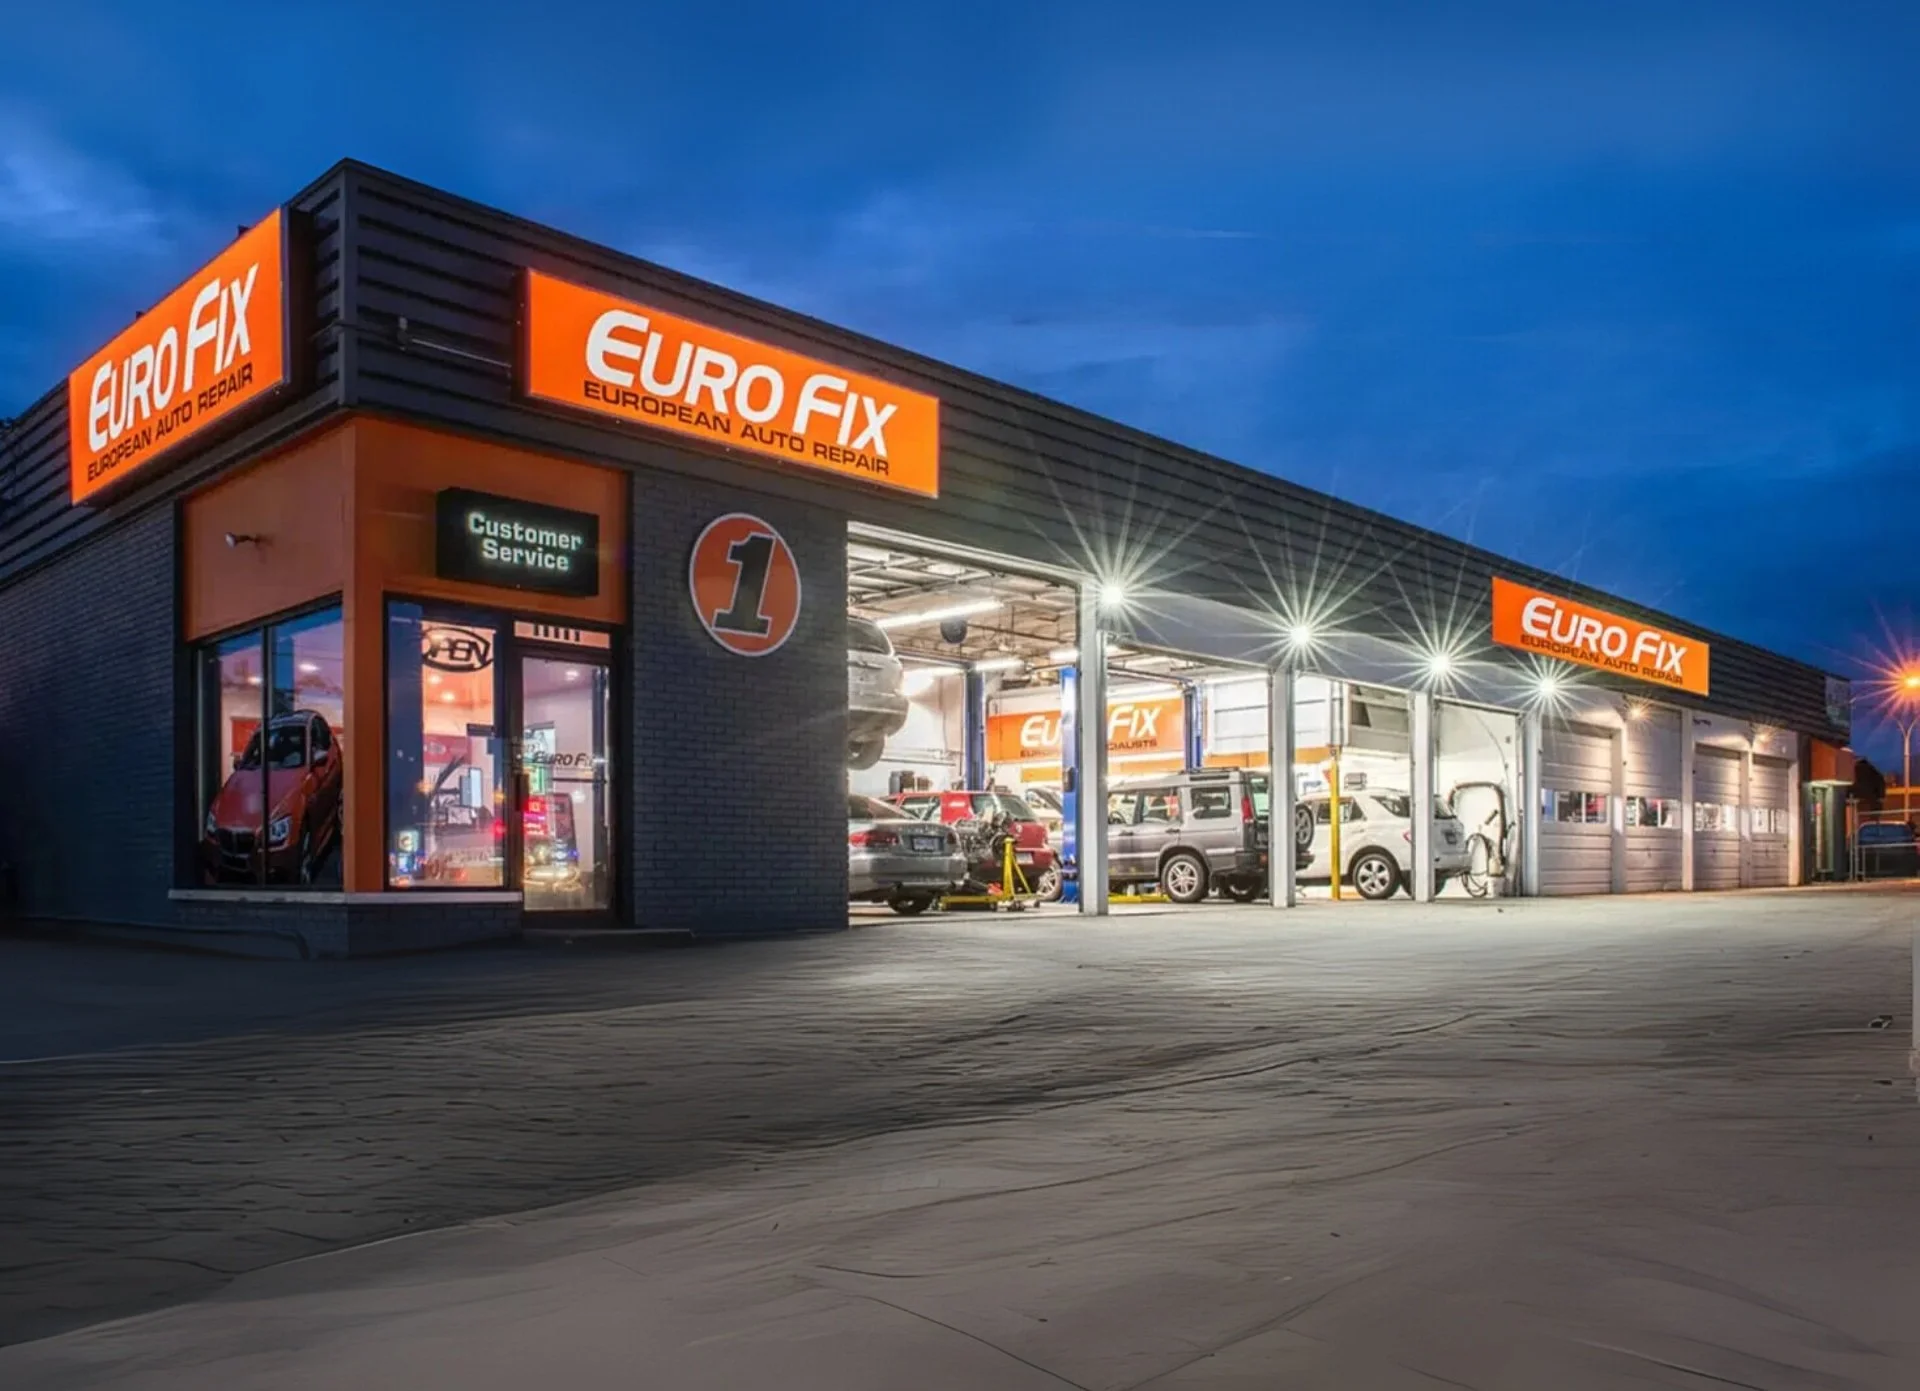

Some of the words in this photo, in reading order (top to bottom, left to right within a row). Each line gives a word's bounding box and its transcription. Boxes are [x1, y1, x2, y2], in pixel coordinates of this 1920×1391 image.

[89, 326, 179, 453] EURO
[183, 262, 259, 393] FIX
[585, 309, 784, 423] EURO
[792, 373, 898, 458] FIX
[87, 426, 151, 483] EUROPEAN
[155, 400, 193, 441] AUTO
[198, 362, 253, 416] REPAIR
[583, 380, 731, 434] EUROPEAN
[740, 423, 806, 454] AUTO
[813, 441, 890, 476] REPAIR
[467, 511, 583, 550] Customer
[481, 538, 570, 571] Service
[712, 531, 777, 639] 1
[1521, 596, 1629, 658] EURO
[1630, 630, 1688, 676] FIX
[1521, 634, 1600, 664] EUROPEAN
[1603, 657, 1638, 673] AUTO
[1642, 667, 1683, 685] REPAIR
[1020, 715, 1062, 748] EU
